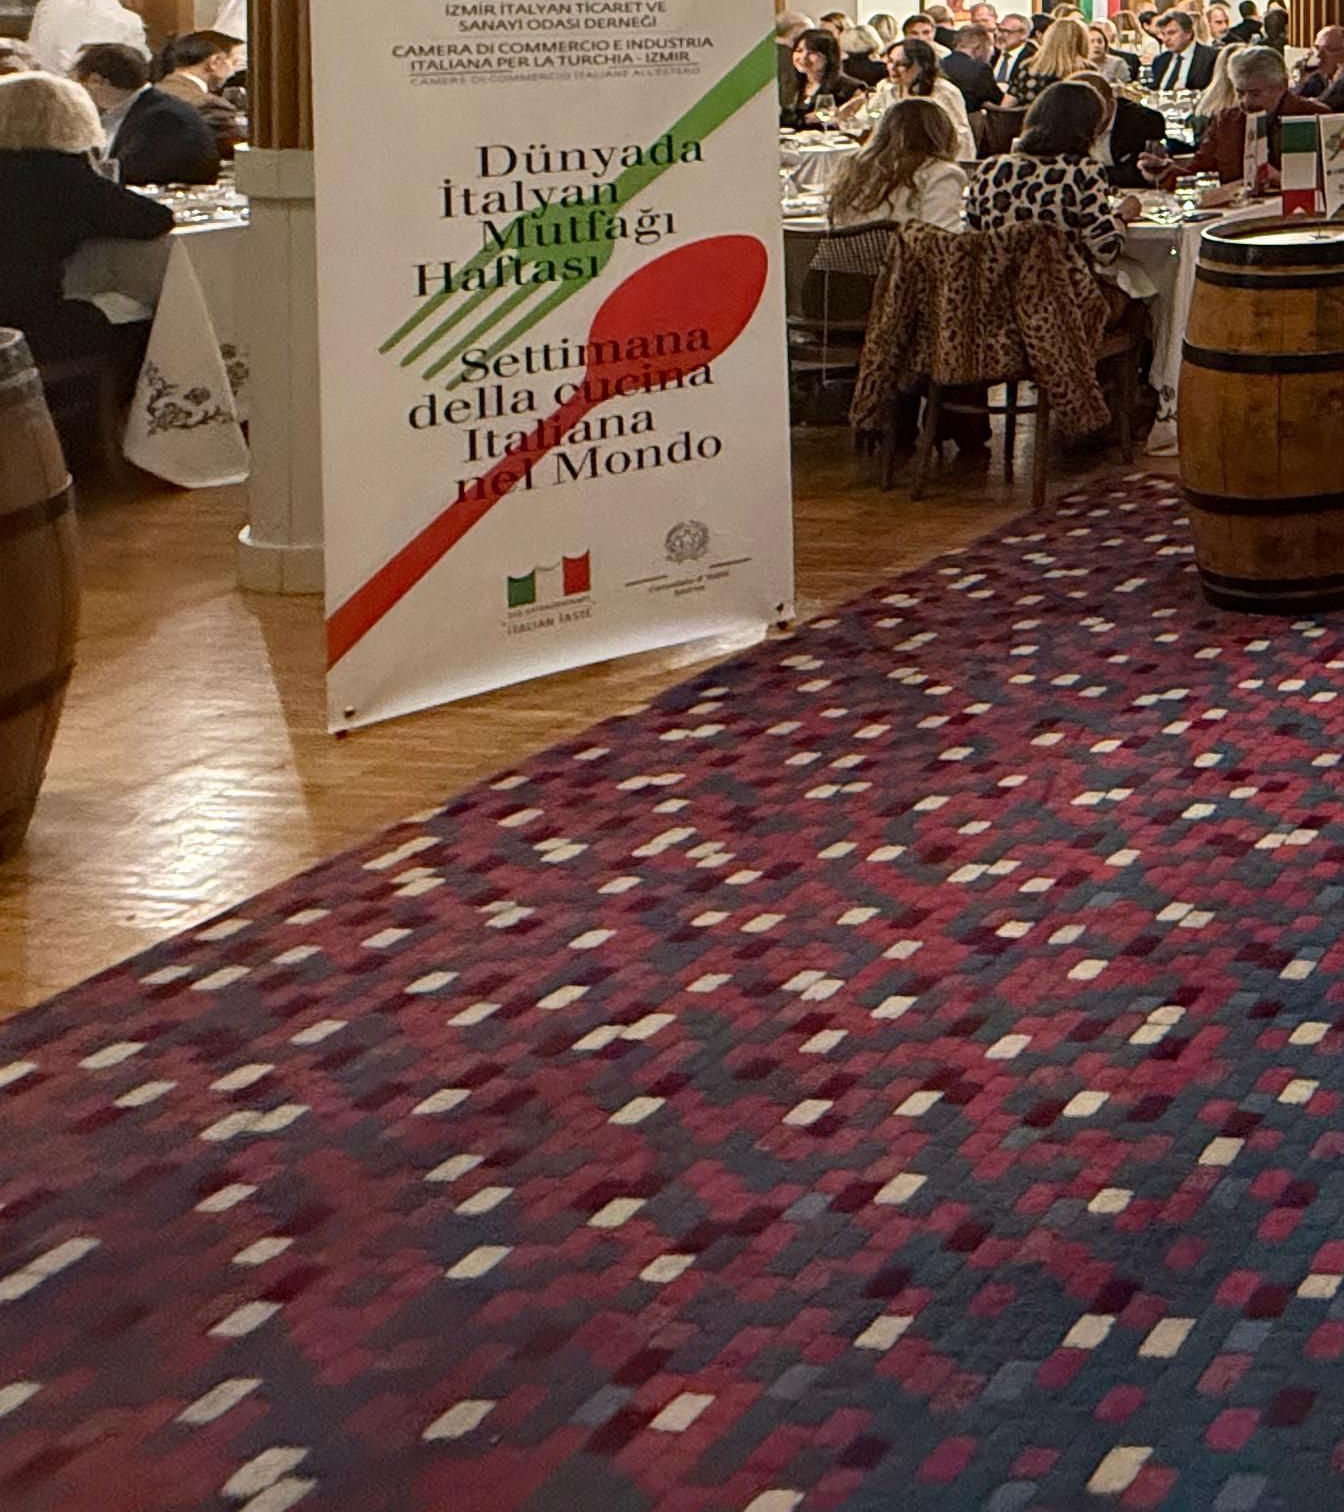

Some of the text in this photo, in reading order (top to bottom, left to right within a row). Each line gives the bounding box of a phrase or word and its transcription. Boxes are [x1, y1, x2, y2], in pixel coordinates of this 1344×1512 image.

[445, 0, 667, 17] İZMİR İTALYAN TİCARET VE
[526, 17, 580, 31] ODASI
[392, 36, 714, 57] CAMERA DI COMMERCIO E INDUSTRIA
[411, 57, 493, 72] ITALIANA
[497, 56, 530, 69] PER
[534, 55, 555, 68] LA
[559, 52, 634, 66] TURCHIA
[475, 133, 704, 179] Dünyada
[439, 178, 620, 219] İtalyan
[479, 206, 679, 252] Mutfağı
[412, 248, 600, 299] Haftası
[459, 326, 712, 384] Settimana
[407, 360, 716, 430] della cucina
[462, 407, 657, 464] Italiana
[454, 431, 723, 505] nel Mondo
